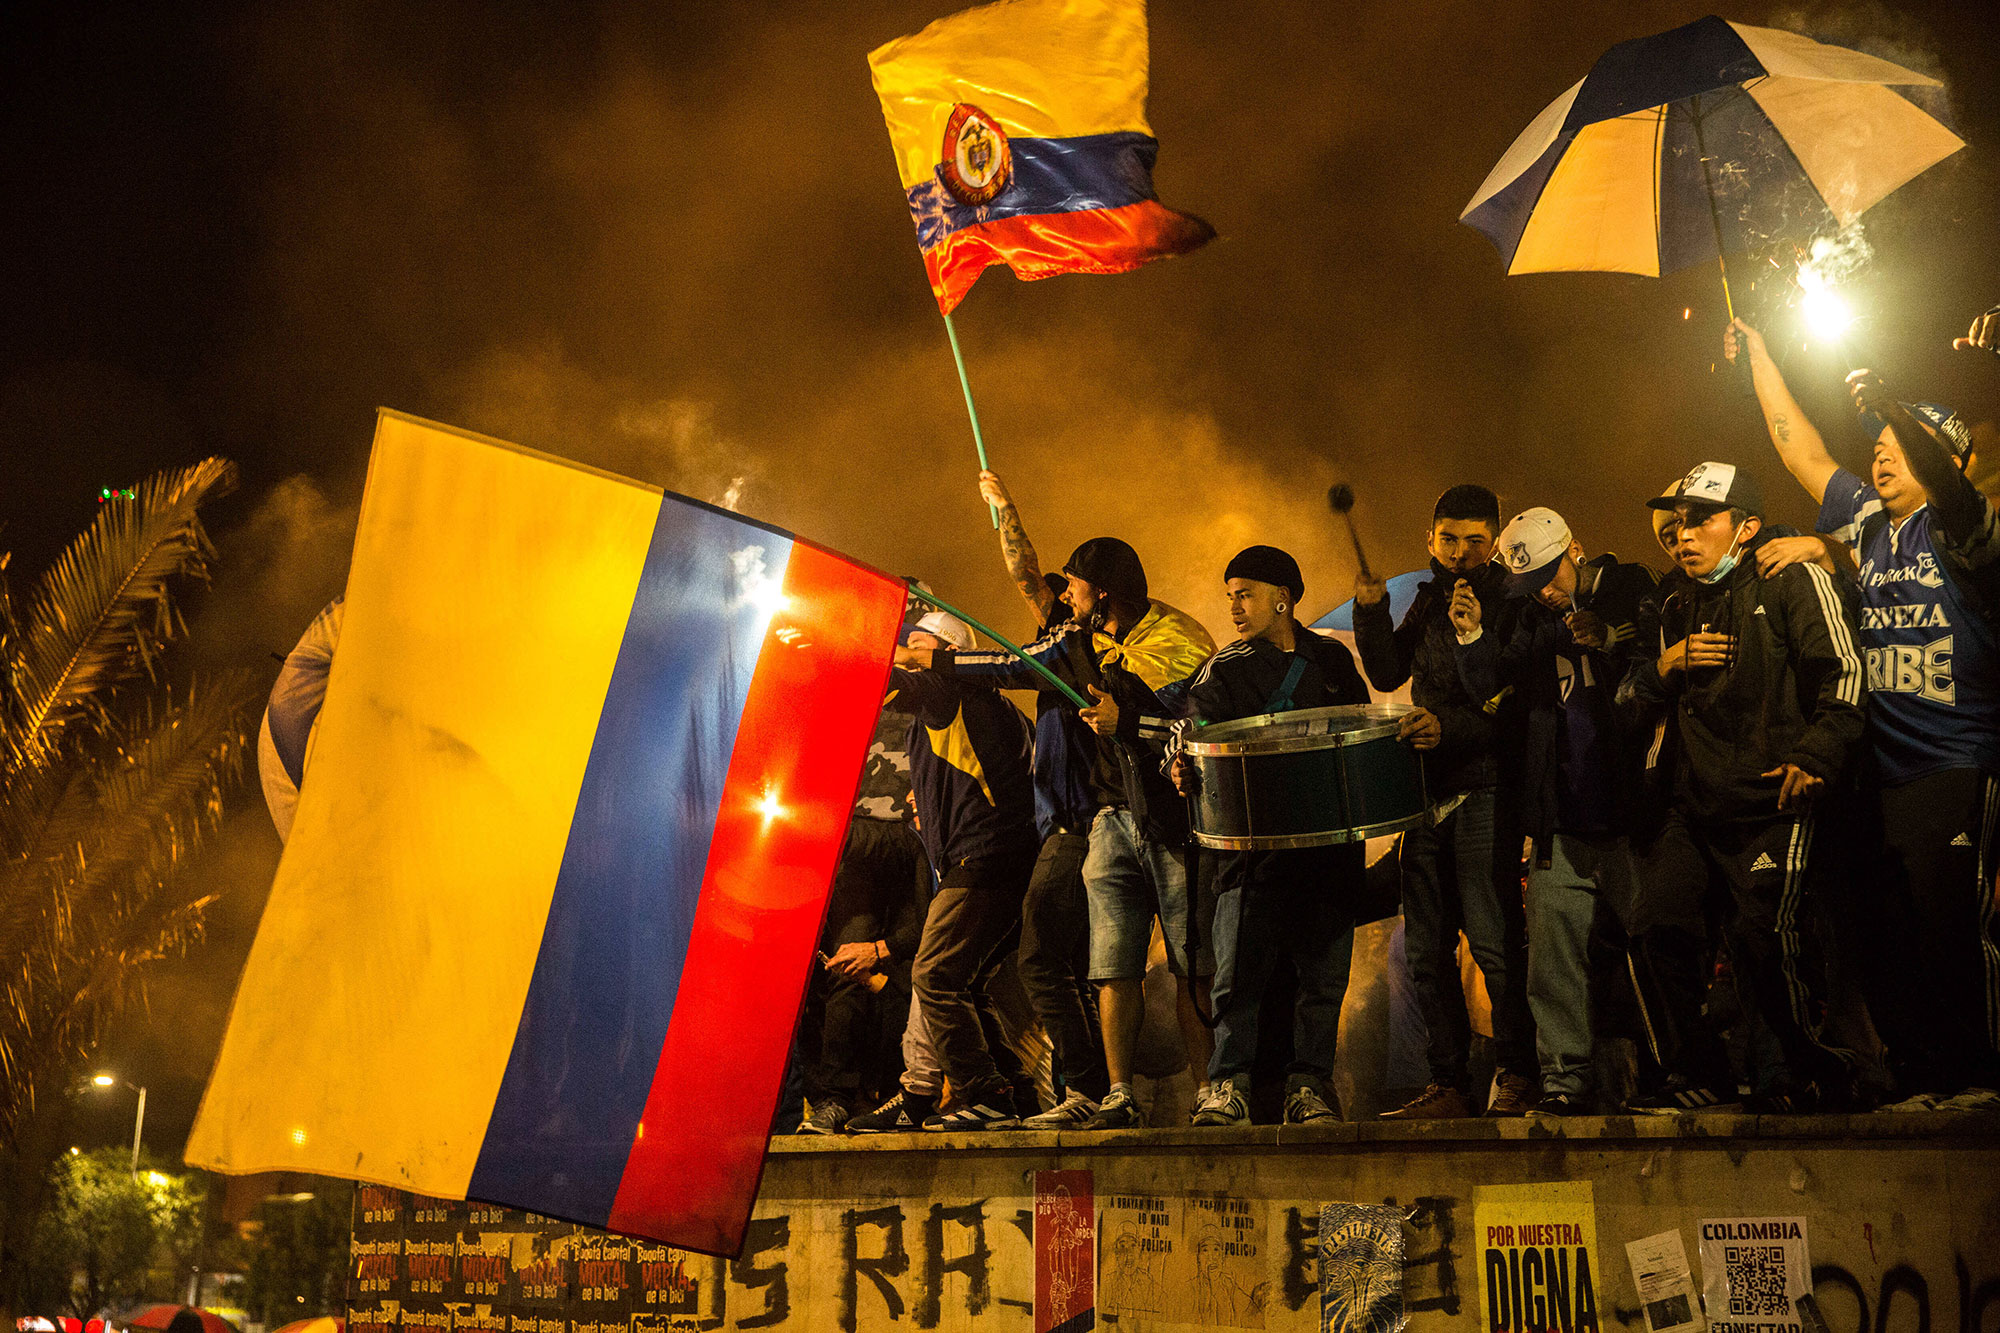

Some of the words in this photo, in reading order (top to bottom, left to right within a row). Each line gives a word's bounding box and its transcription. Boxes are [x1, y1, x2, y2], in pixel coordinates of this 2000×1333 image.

[1039, 1204, 1051, 1216] DIO
[1138, 1212, 1147, 1225] LO
[1079, 1216, 1087, 1228] LA
[1152, 1227, 1160, 1239] LA
[1487, 1225, 1515, 1247] POR
[1518, 1223, 1583, 1246] NUESTRA
[1702, 1222, 1802, 1241] COLOMBIA
[408, 1255, 452, 1282] MORTAL
[462, 1256, 508, 1285] MORTAL
[579, 1260, 630, 1290] MORTAL
[582, 1287, 593, 1301] de
[594, 1286, 602, 1301] la
[604, 1283, 620, 1301] bici
[645, 1290, 657, 1304] de
[659, 1289, 667, 1304] la
[669, 1286, 685, 1304] bici
[1485, 1247, 1600, 1333] DIGNA
